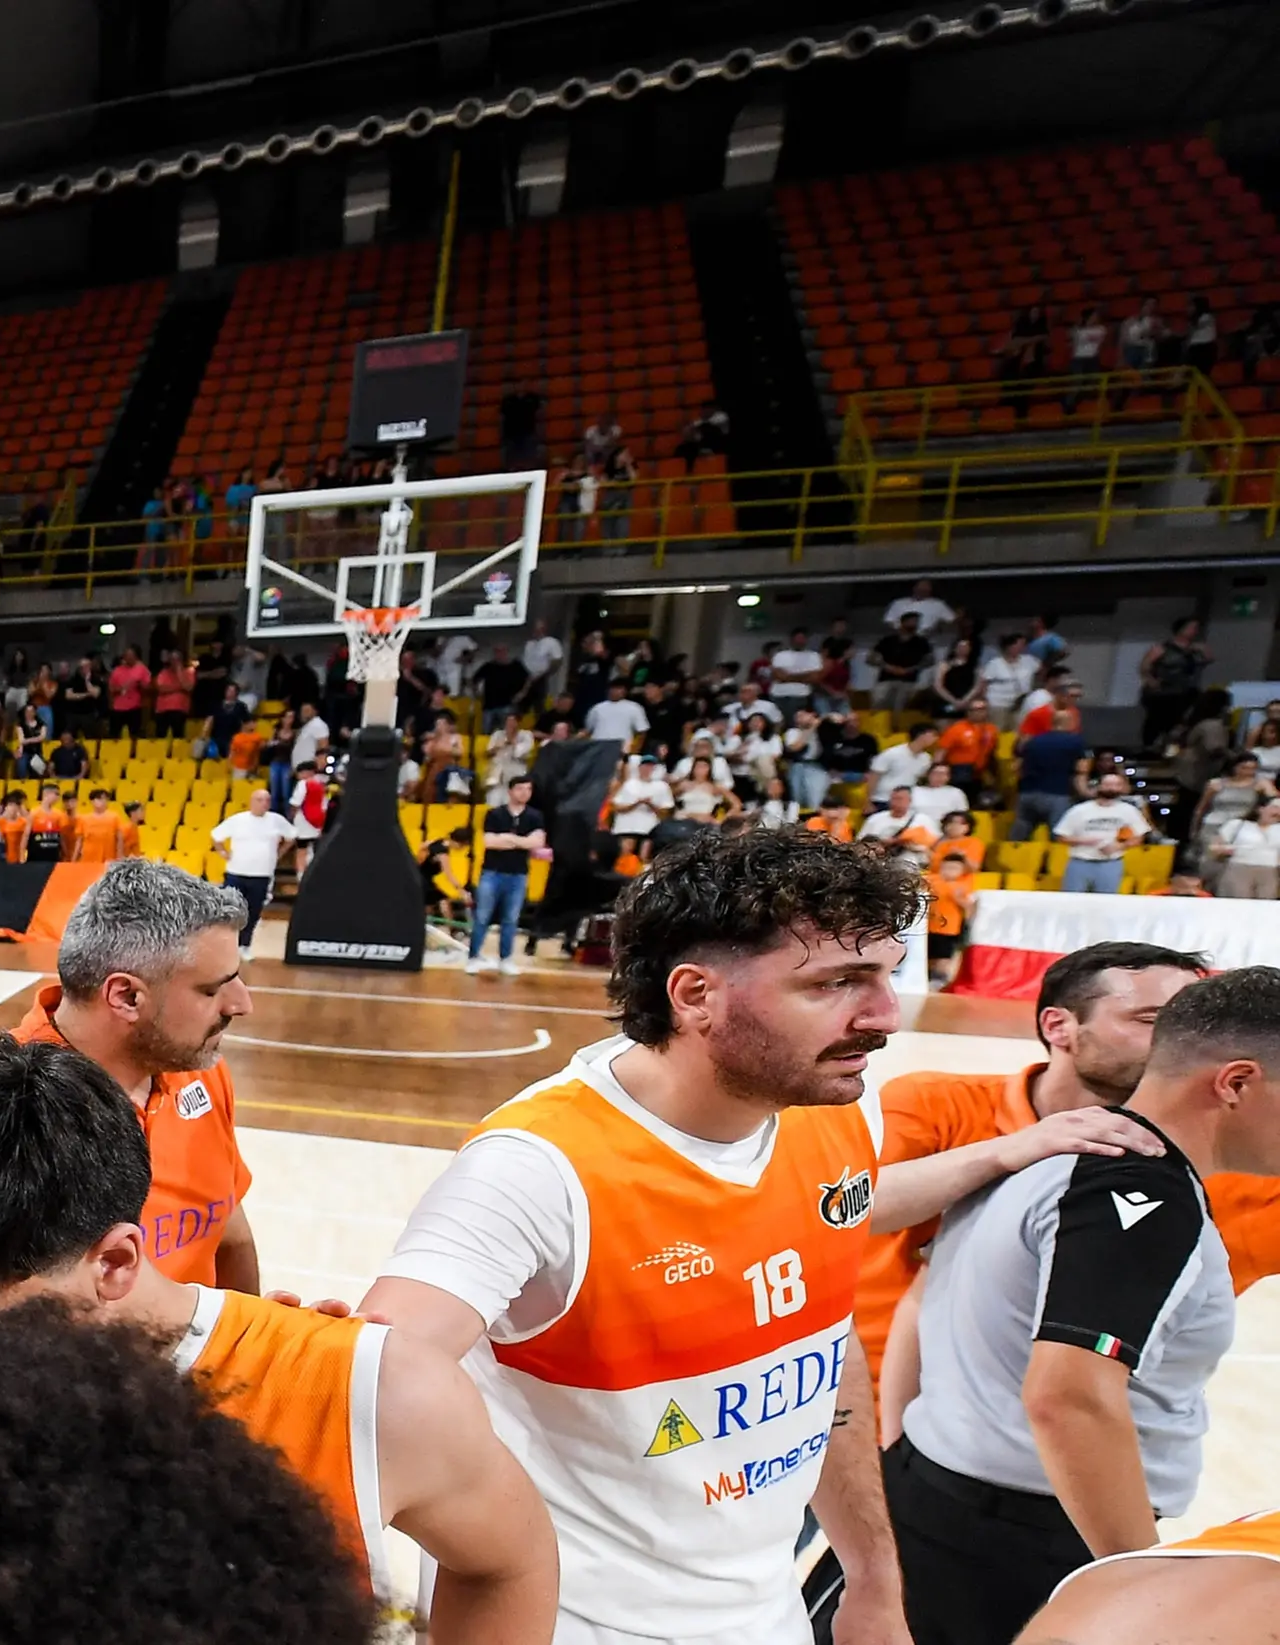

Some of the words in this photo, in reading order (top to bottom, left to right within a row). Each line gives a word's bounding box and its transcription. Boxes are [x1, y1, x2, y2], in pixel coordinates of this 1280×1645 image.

[839, 1177, 870, 1222] VIOLA
[664, 1255, 715, 1285] GECO
[743, 1248, 807, 1327] 18
